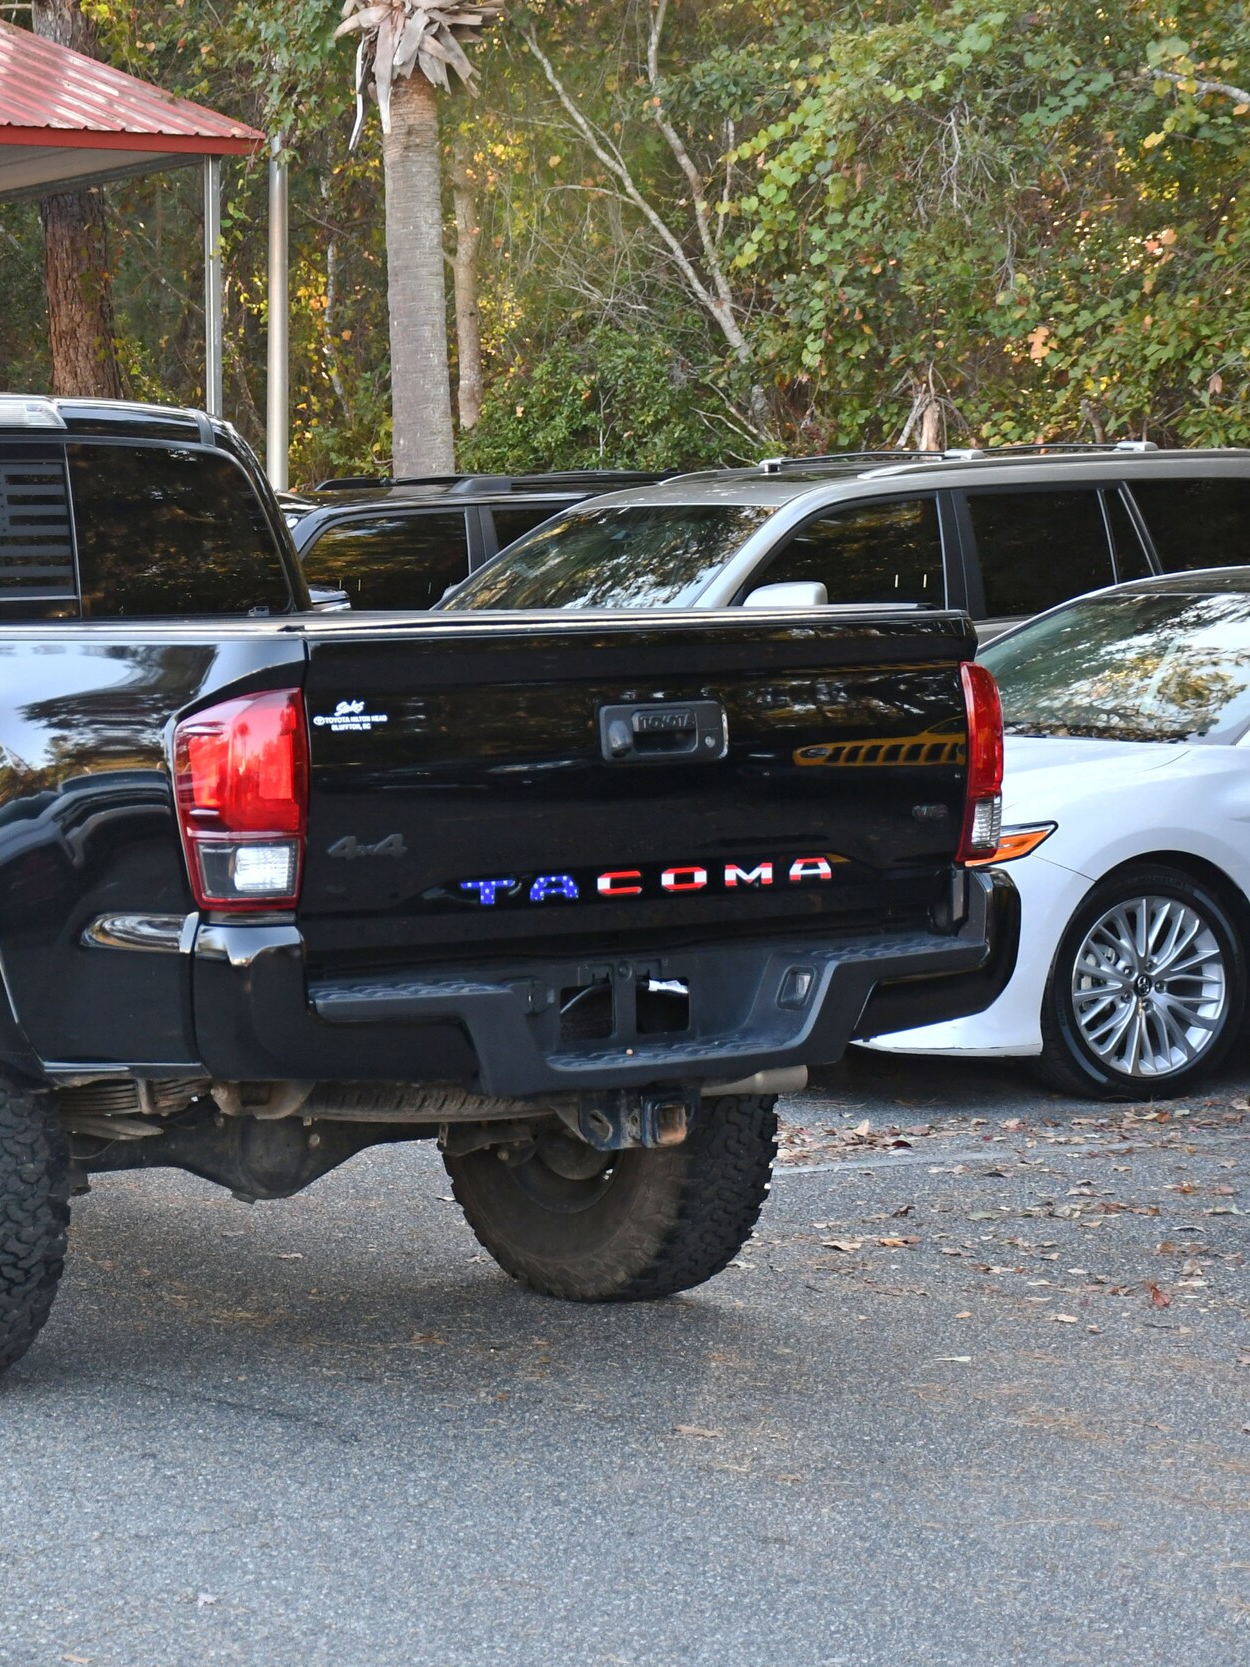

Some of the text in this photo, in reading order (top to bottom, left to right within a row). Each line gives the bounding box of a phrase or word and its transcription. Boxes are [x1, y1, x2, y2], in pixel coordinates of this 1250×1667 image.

[325, 716, 351, 725] TOYOTA
[327, 833, 408, 860] 4x4
[460, 856, 833, 906] TACOMA
